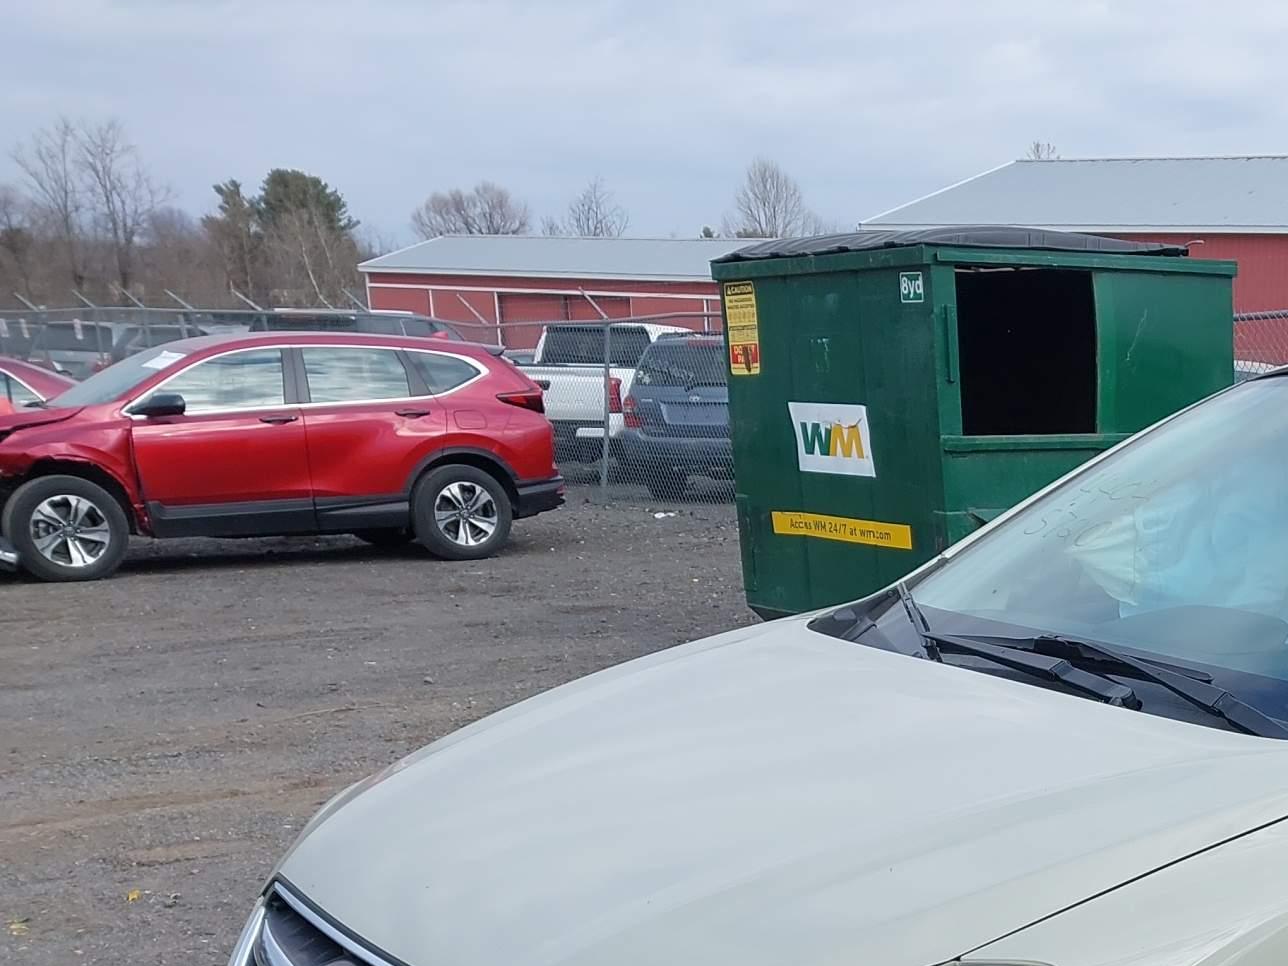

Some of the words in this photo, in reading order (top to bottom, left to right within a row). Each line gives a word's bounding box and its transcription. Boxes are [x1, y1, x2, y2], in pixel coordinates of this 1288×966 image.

[902, 276, 922, 299] 8yd
[800, 421, 865, 459] WM
[813, 519, 827, 532] WM
[829, 523, 847, 535] 24/7
[849, 526, 858, 537] at
